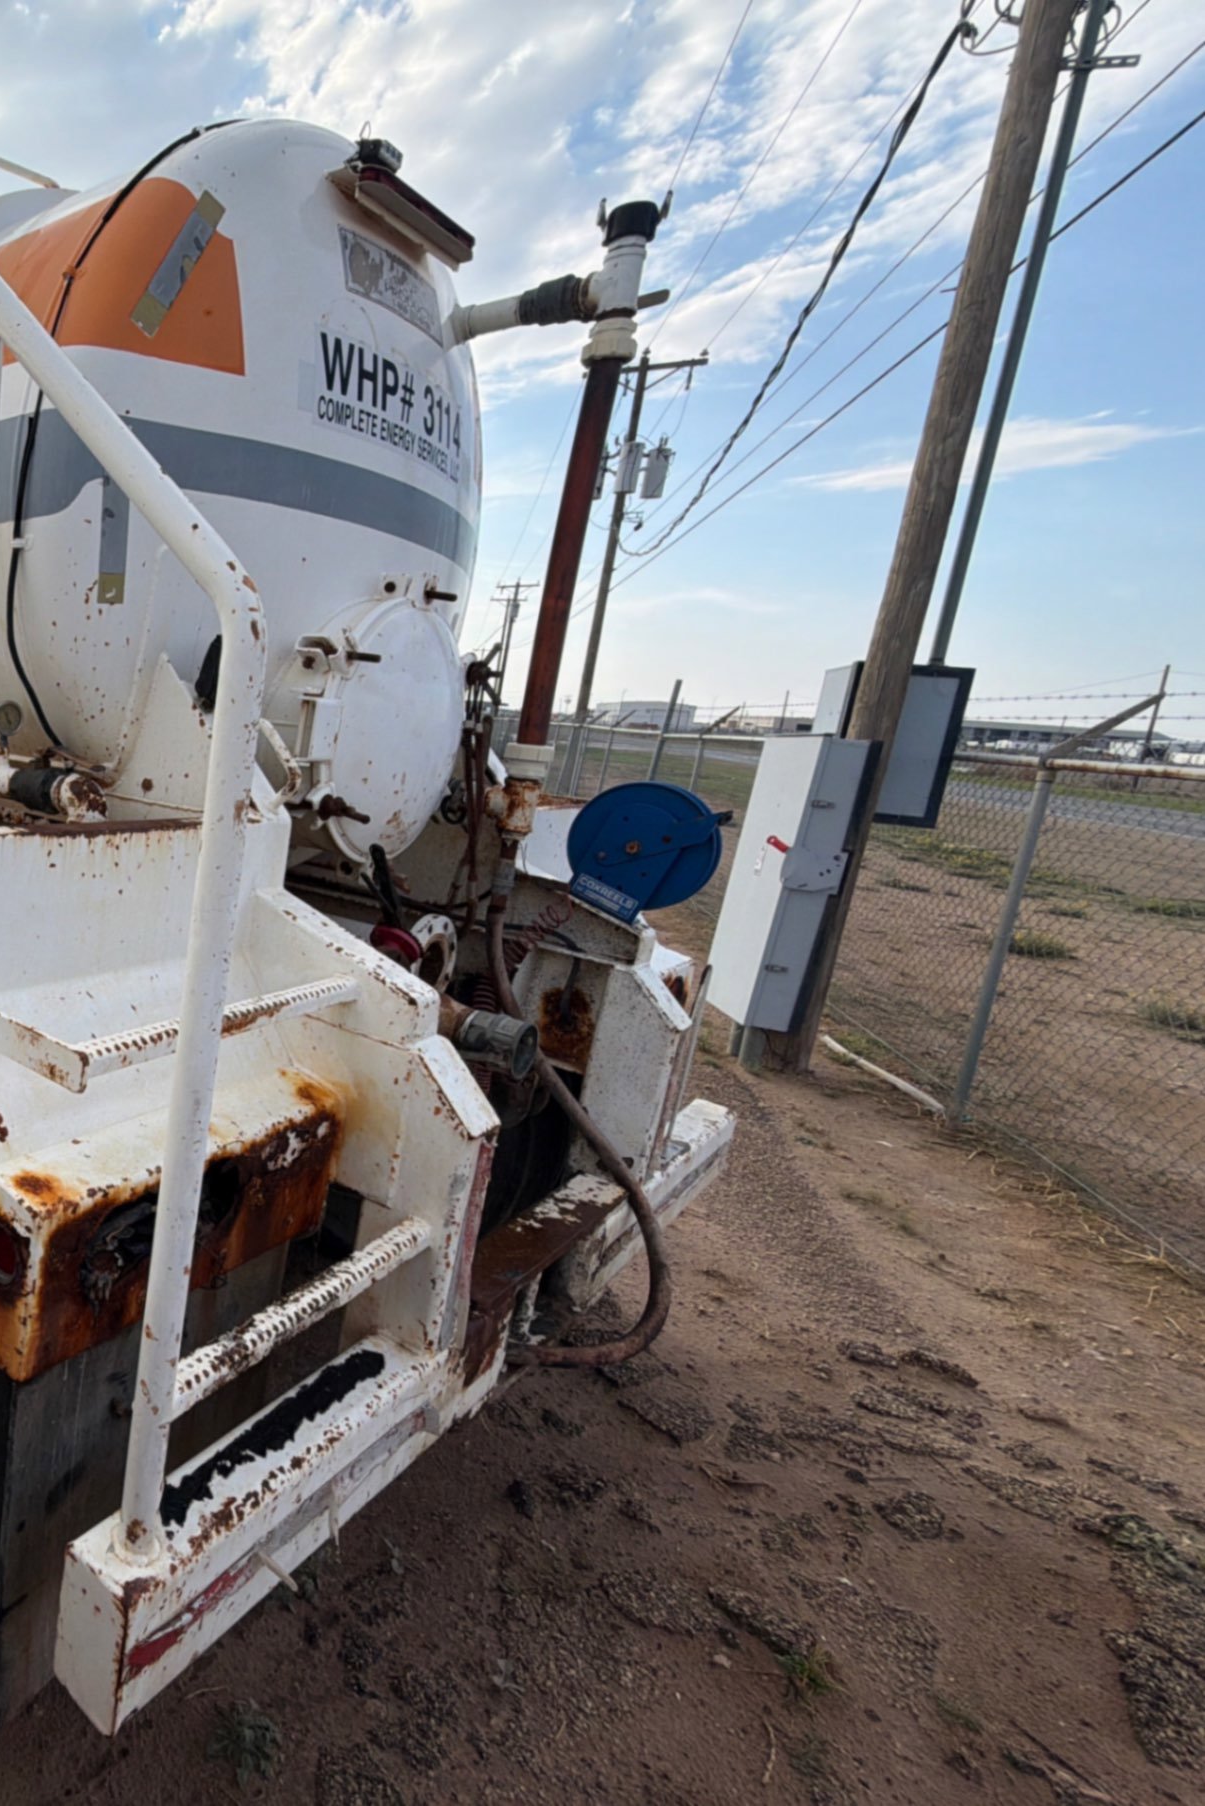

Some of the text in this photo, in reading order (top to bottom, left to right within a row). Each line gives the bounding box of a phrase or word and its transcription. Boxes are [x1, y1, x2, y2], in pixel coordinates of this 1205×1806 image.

[317, 395, 378, 438] COMPLETE
[379, 418, 416, 454] ENERGY
[416, 436, 448, 475] SERVICES
[320, 332, 461, 458] WHP# 3114
[578, 876, 634, 910] COXREELS
